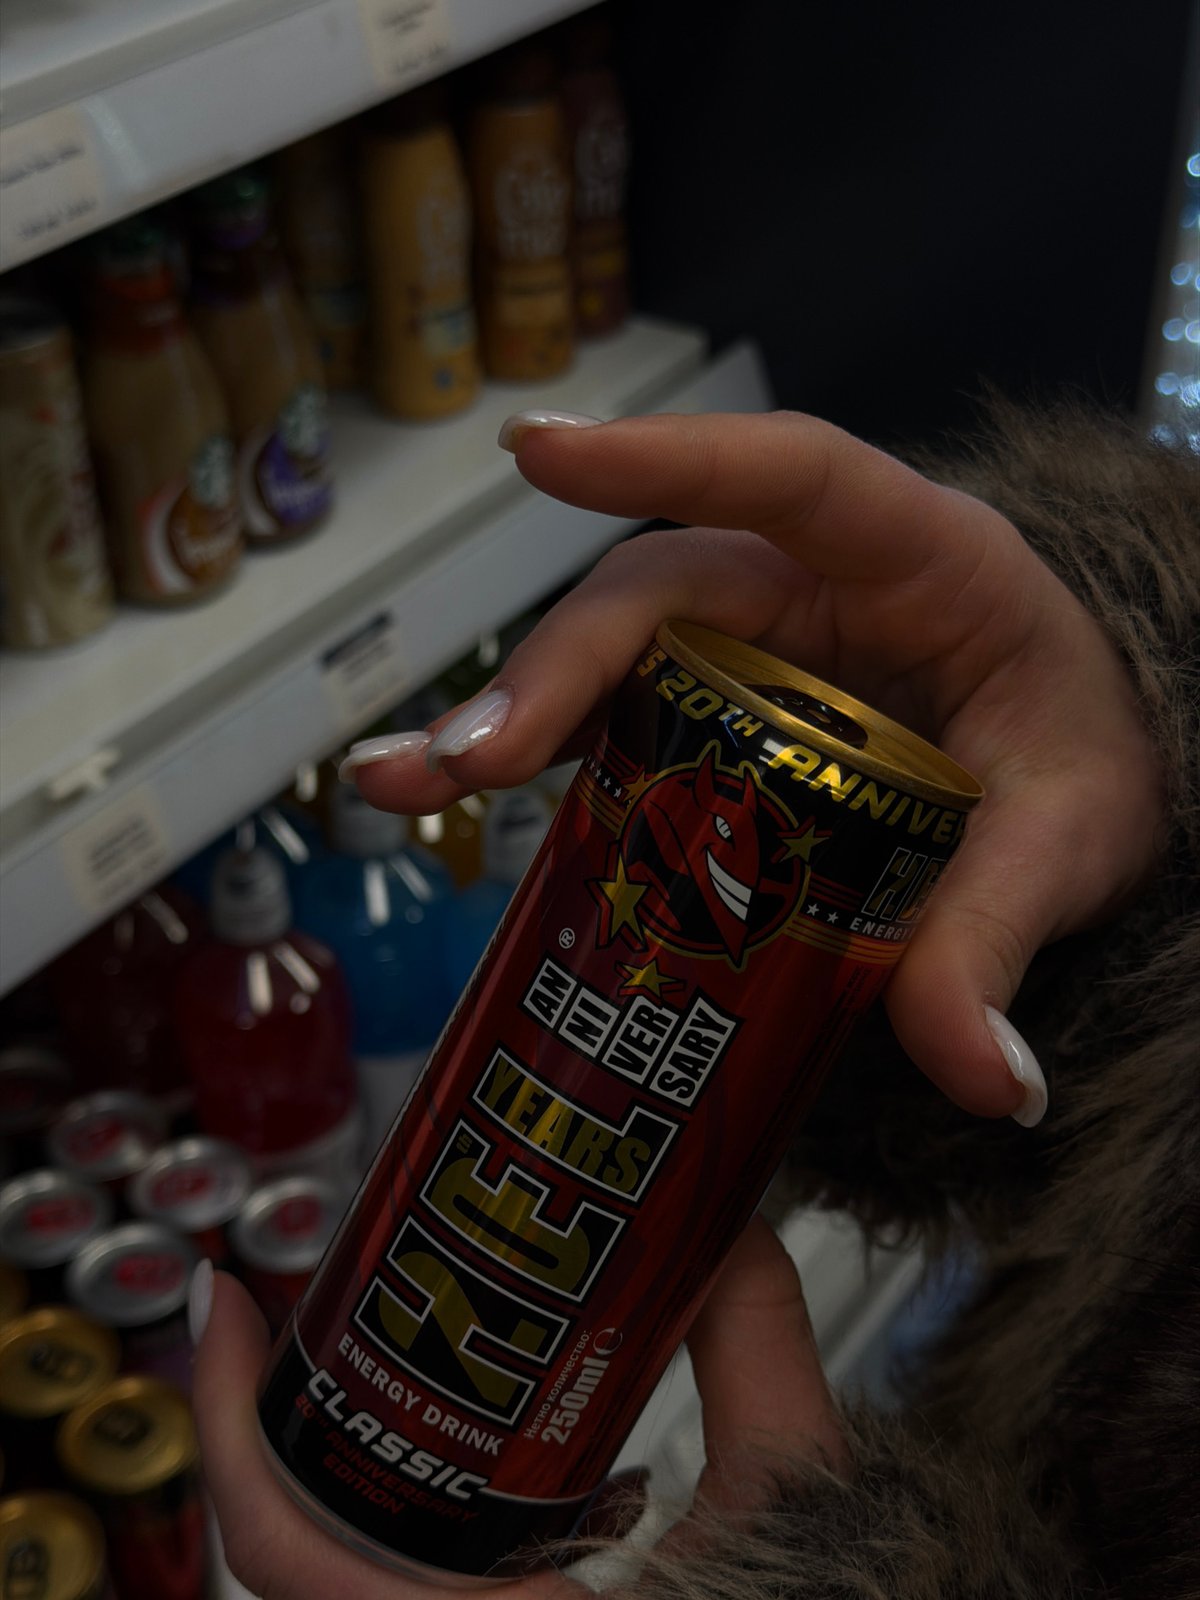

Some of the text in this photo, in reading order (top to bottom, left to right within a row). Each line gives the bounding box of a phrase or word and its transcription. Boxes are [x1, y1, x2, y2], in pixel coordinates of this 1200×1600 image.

[655, 669, 765, 738] 20TH
[606, 1004, 673, 1076] VER
[657, 1007, 729, 1099] SARY
[483, 1056, 652, 1193] YEARS
[308, 1368, 489, 1500] CLASSIC
[338, 1332, 504, 1456] ENERGY DRINK
[541, 1355, 610, 1446] 250ml
[321, 1451, 408, 1517] EDITION
[324, 1430, 480, 1522] ANNIVERSARY
